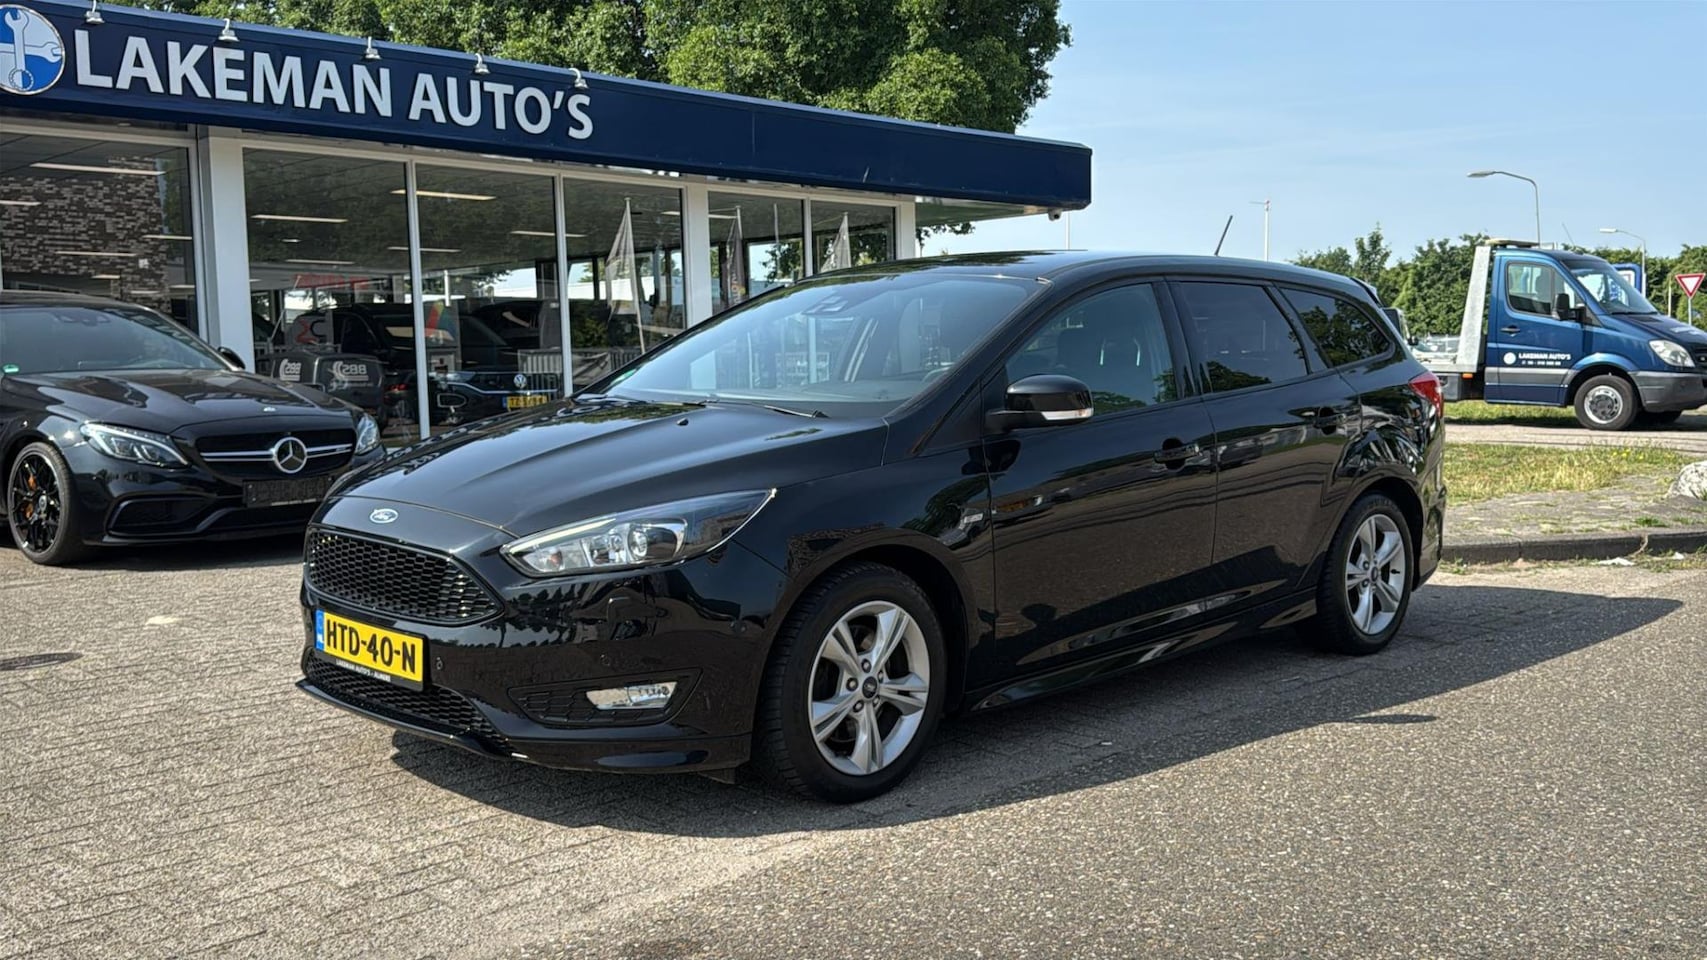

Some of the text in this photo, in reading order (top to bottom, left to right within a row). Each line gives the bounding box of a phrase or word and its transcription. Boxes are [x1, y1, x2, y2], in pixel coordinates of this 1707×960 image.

[74, 29, 594, 140] LAKEMAN AUTO'S
[326, 618, 416, 675] HTD-40-N
